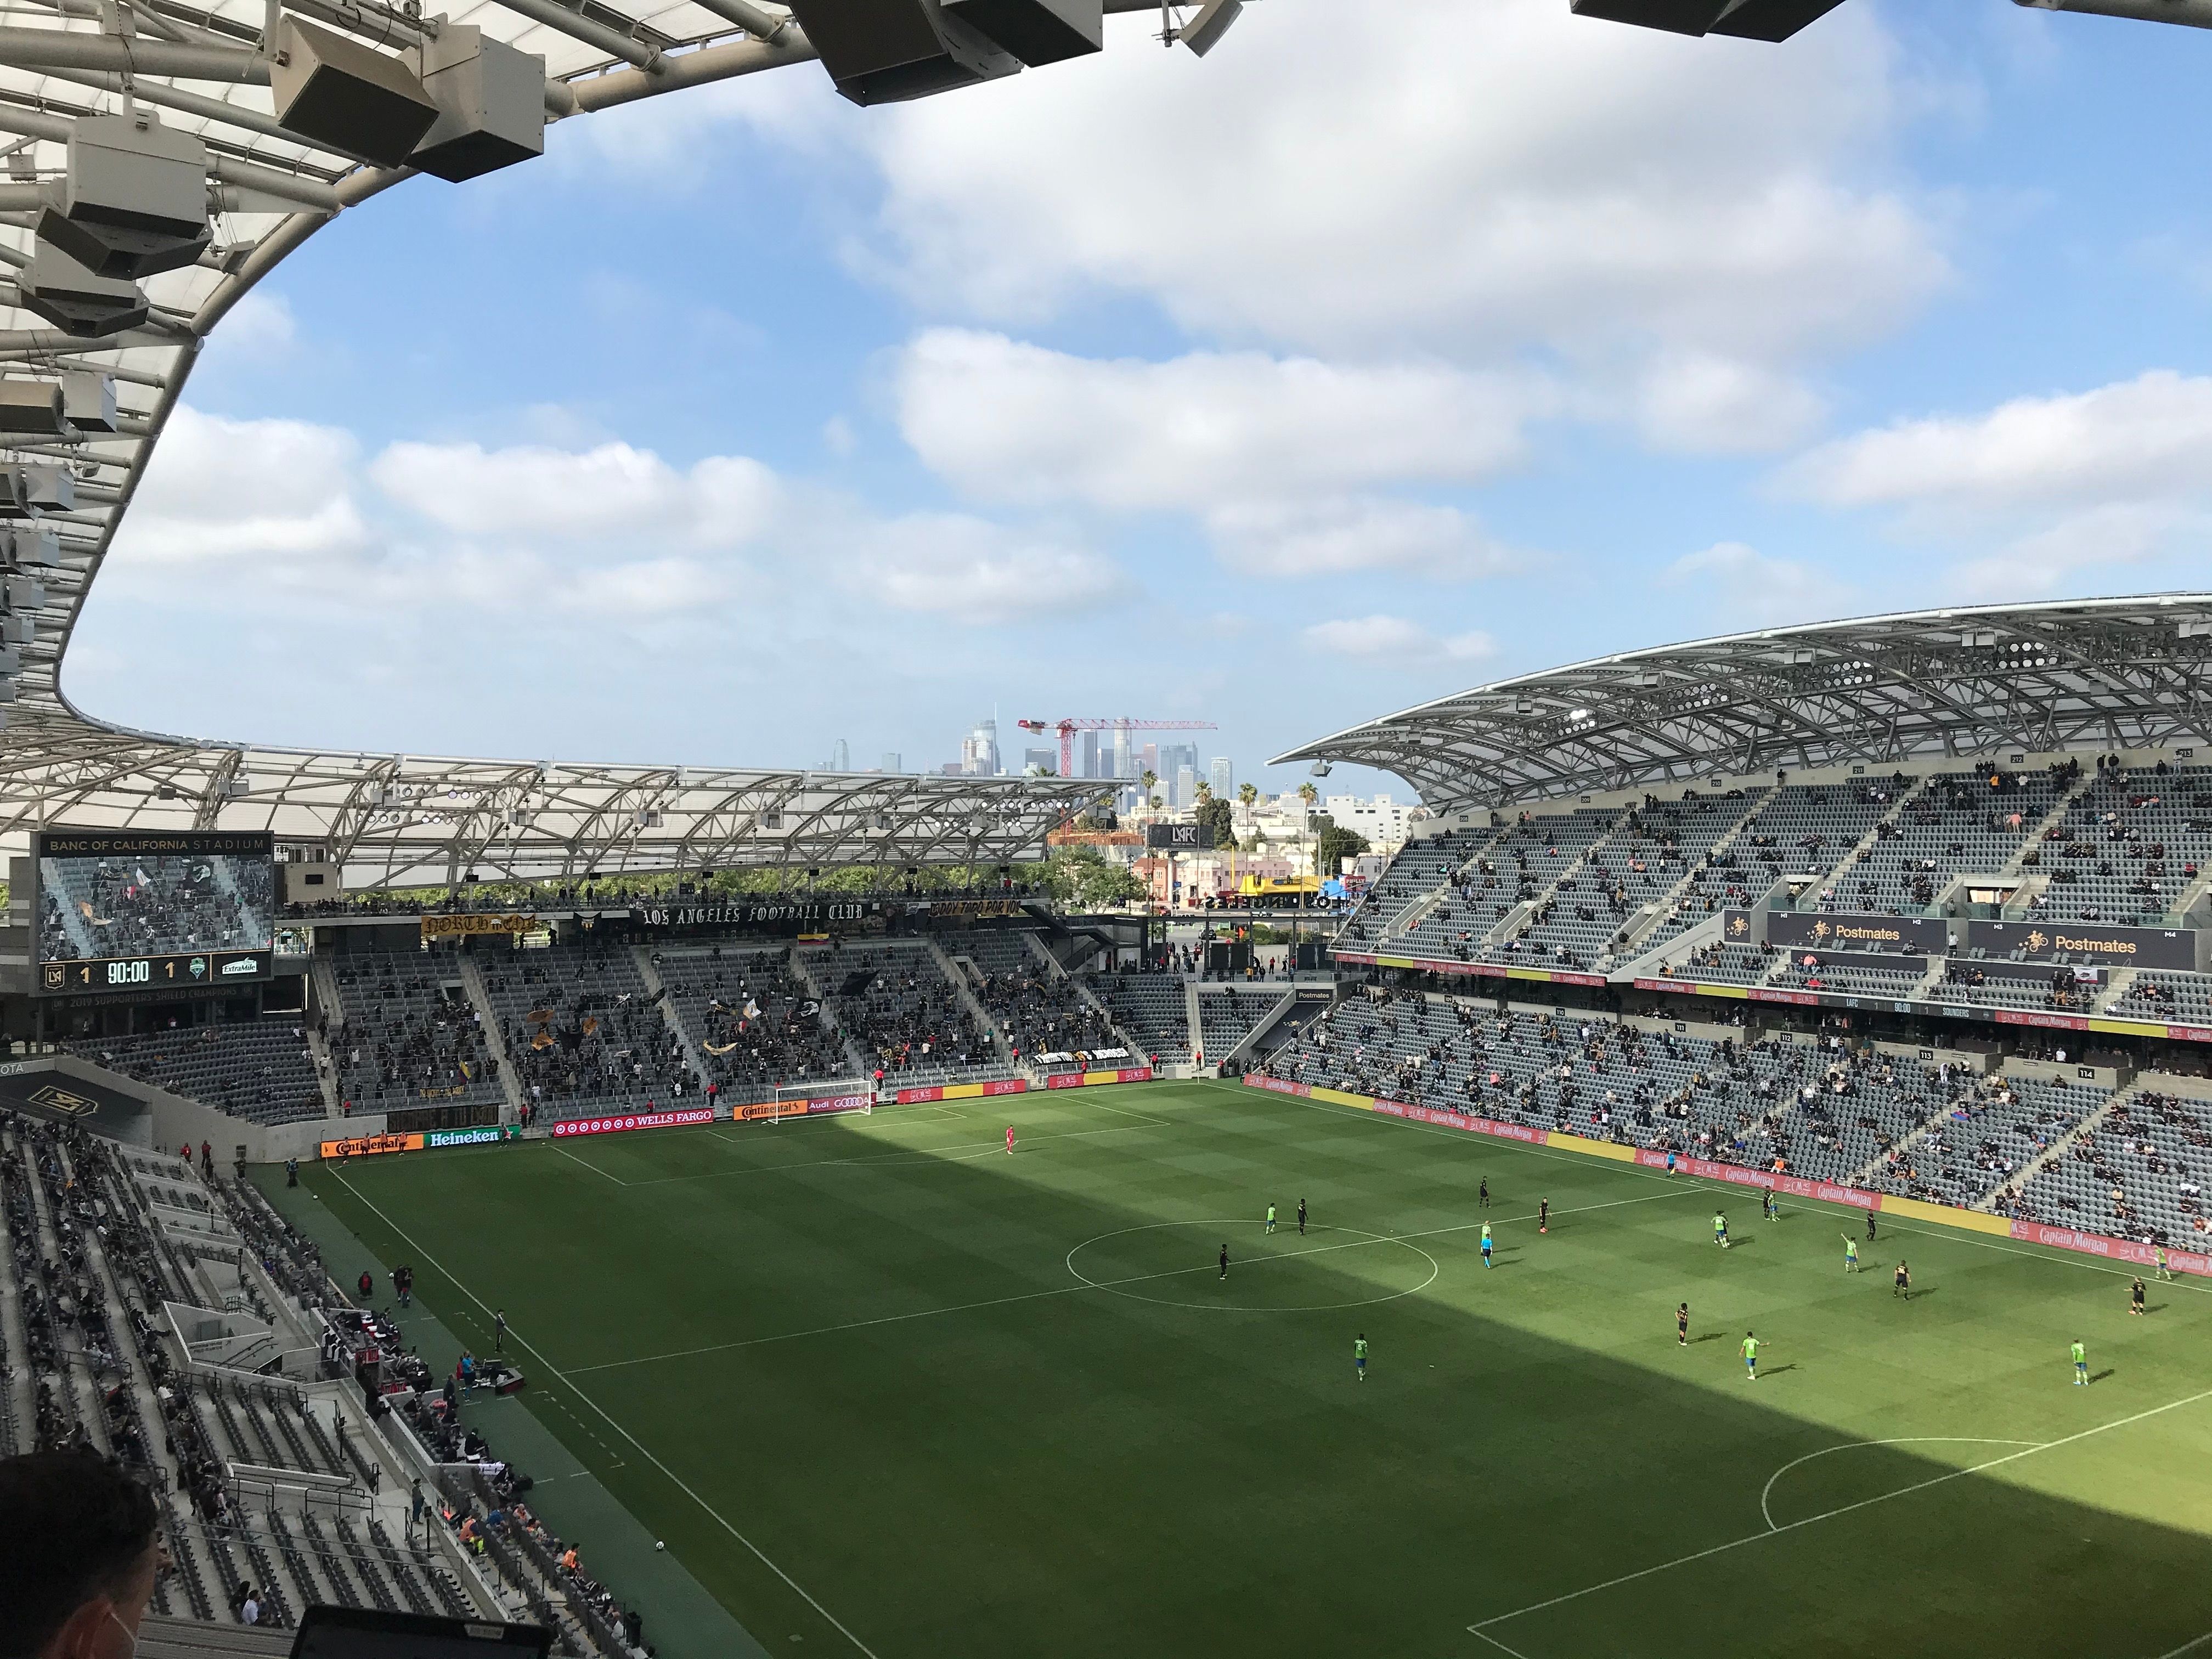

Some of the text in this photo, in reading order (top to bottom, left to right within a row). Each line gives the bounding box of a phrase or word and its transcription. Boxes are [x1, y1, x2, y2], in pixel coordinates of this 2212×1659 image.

[1172, 827, 1196, 842] LAFC
[50, 840, 263, 850] BANC OF CALIFORNIA STADIUM
[643, 905, 862, 925] LOS ANGELES FOOTBALL CLUB
[424, 915, 489, 933] NORTH
[1836, 925, 1900, 940] Postmates
[2056, 936, 2136, 953] Postmates
[80, 967, 90, 983] 1
[108, 961, 149, 984] 90:00
[165, 962, 175, 978] 1
[224, 964, 256, 973] ExtraMile
[70, 997, 93, 1008] 2019
[156, 990, 187, 1001] SHIELD
[1846, 998, 1859, 1008] LAFC
[1894, 1002, 1911, 1013] 90:00
[1943, 1007, 1970, 1018] SOUNDERS
[2048, 1017, 2071, 1028] Morgan
[1091, 1047, 1130, 1060] HEROES!
[2079, 1069, 2092, 1077] 114
[742, 1103, 792, 1118] Continental
[809, 1101, 829, 1109] Audi
[636, 1110, 712, 1126] WELLS FARGO
[1430, 1111, 1465, 1128] Captain Morgan
[431, 1130, 499, 1147] Heineken
[1494, 1123, 1532, 1141] Captain Morgan
[1643, 1152, 1688, 1171] Captain gan
[1725, 1168, 1774, 1188] Captain Morgan
[1818, 1185, 1872, 1207] Captain Morgan
[2039, 1227, 2108, 1254] Captain Morgan
[2168, 1252, 2204, 1271] Captain
